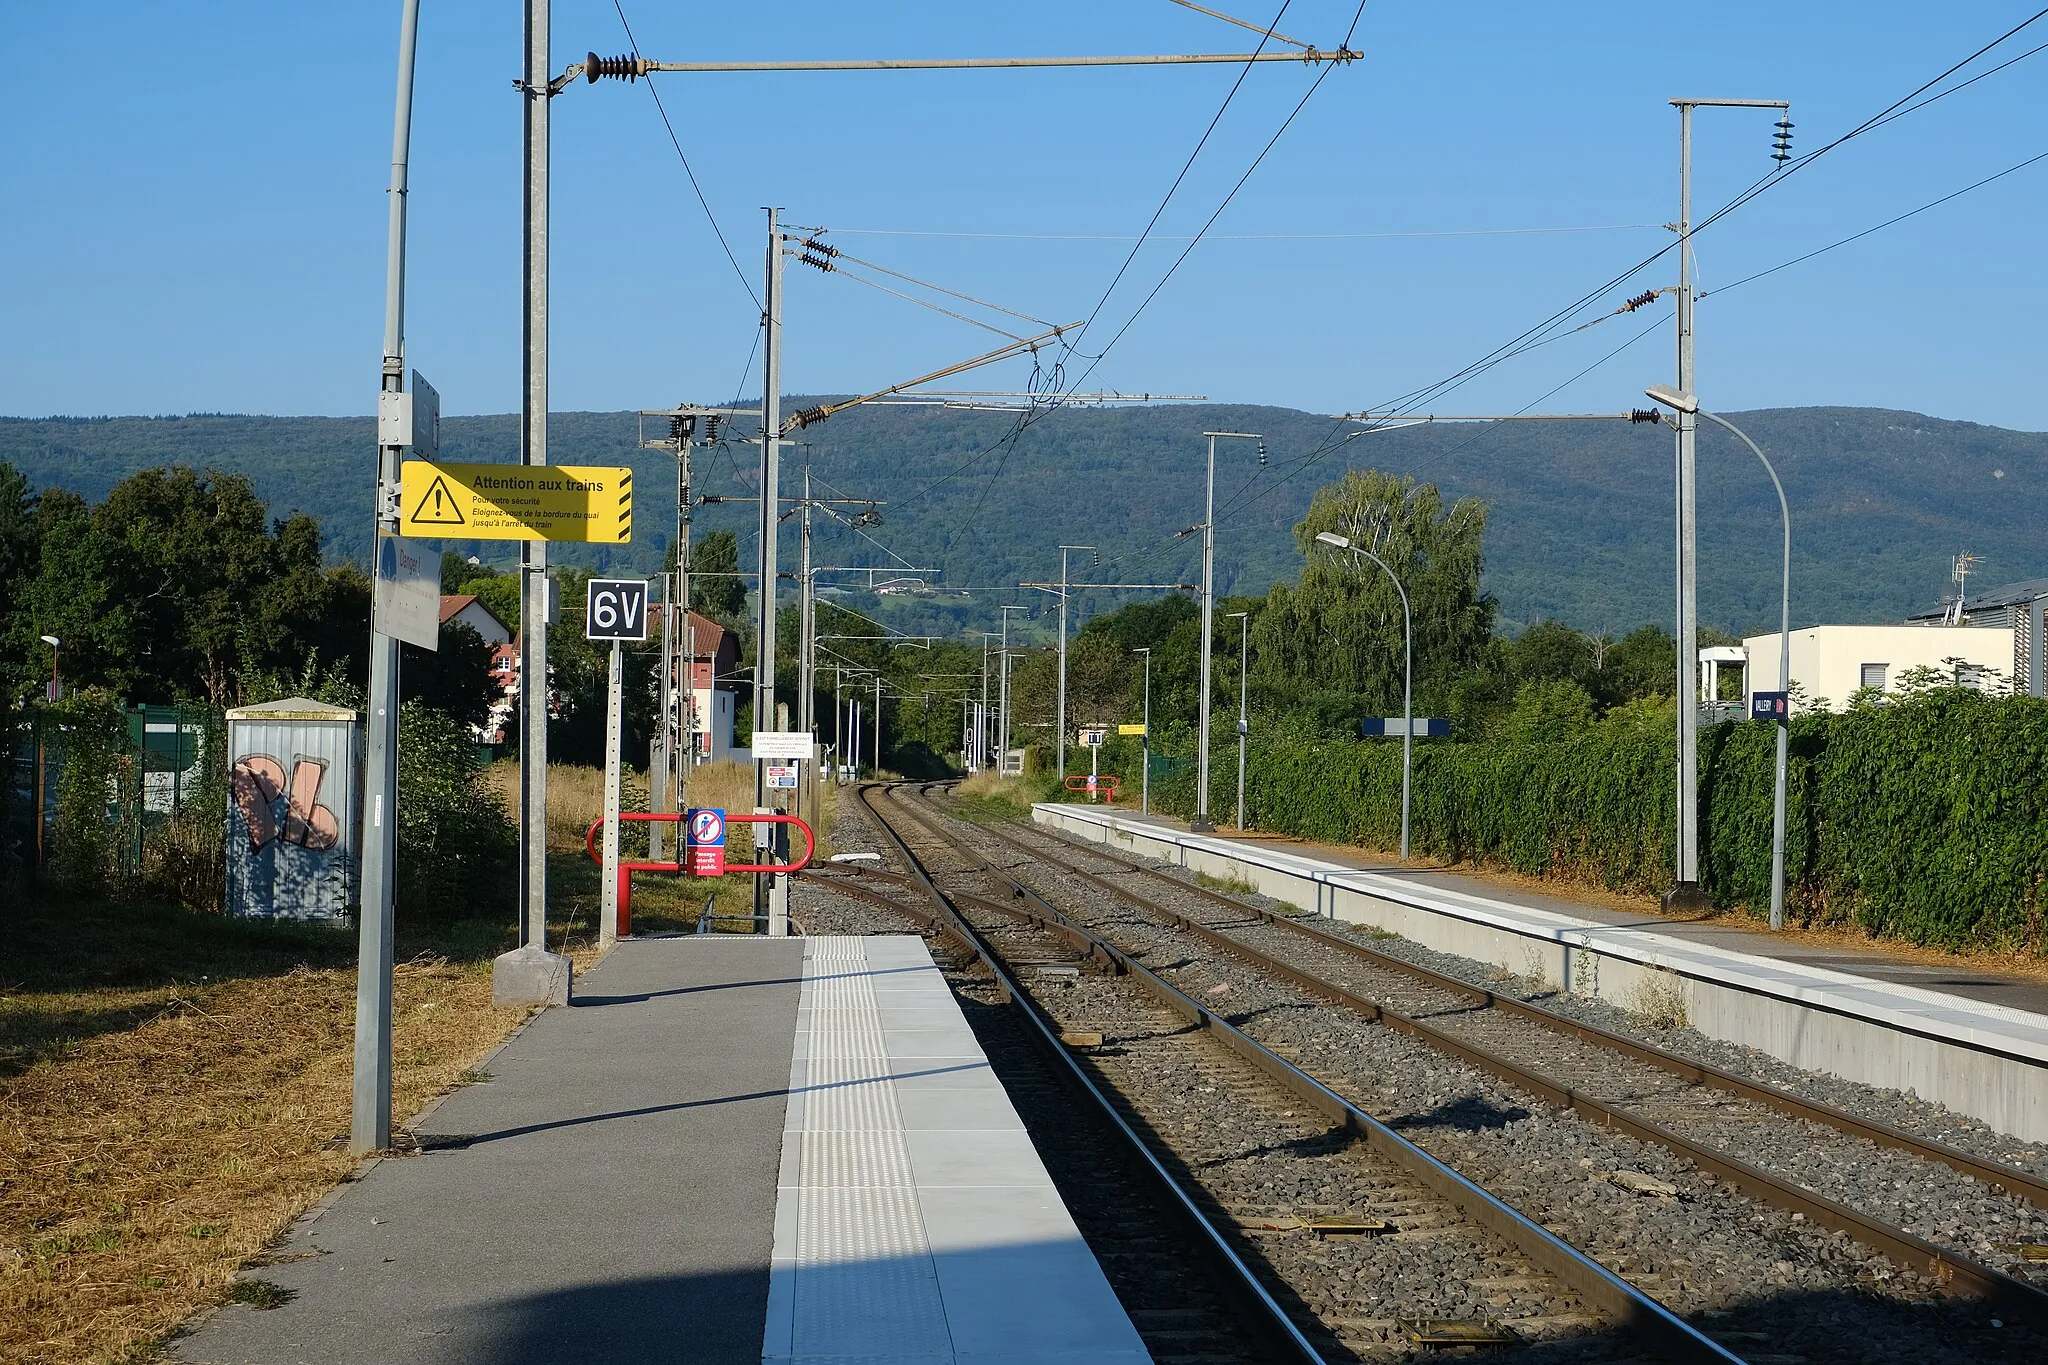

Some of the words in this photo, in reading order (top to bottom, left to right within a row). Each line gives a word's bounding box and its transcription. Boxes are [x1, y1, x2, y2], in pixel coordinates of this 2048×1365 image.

[473, 475, 534, 490] Attention
[538, 480, 562, 491] aux
[566, 478, 604, 492] trains
[472, 496, 489, 504] Pour
[491, 497, 510, 505] votre
[511, 496, 540, 505] sécurité
[472, 507, 522, 517] Eloignez-vous
[572, 511, 582, 519] du
[584, 511, 599, 520] quai
[472, 519, 500, 528] jusqu'à
[501, 519, 523, 528] l'arrêt
[535, 520, 552, 529] train
[594, 591, 640, 628] 6V
